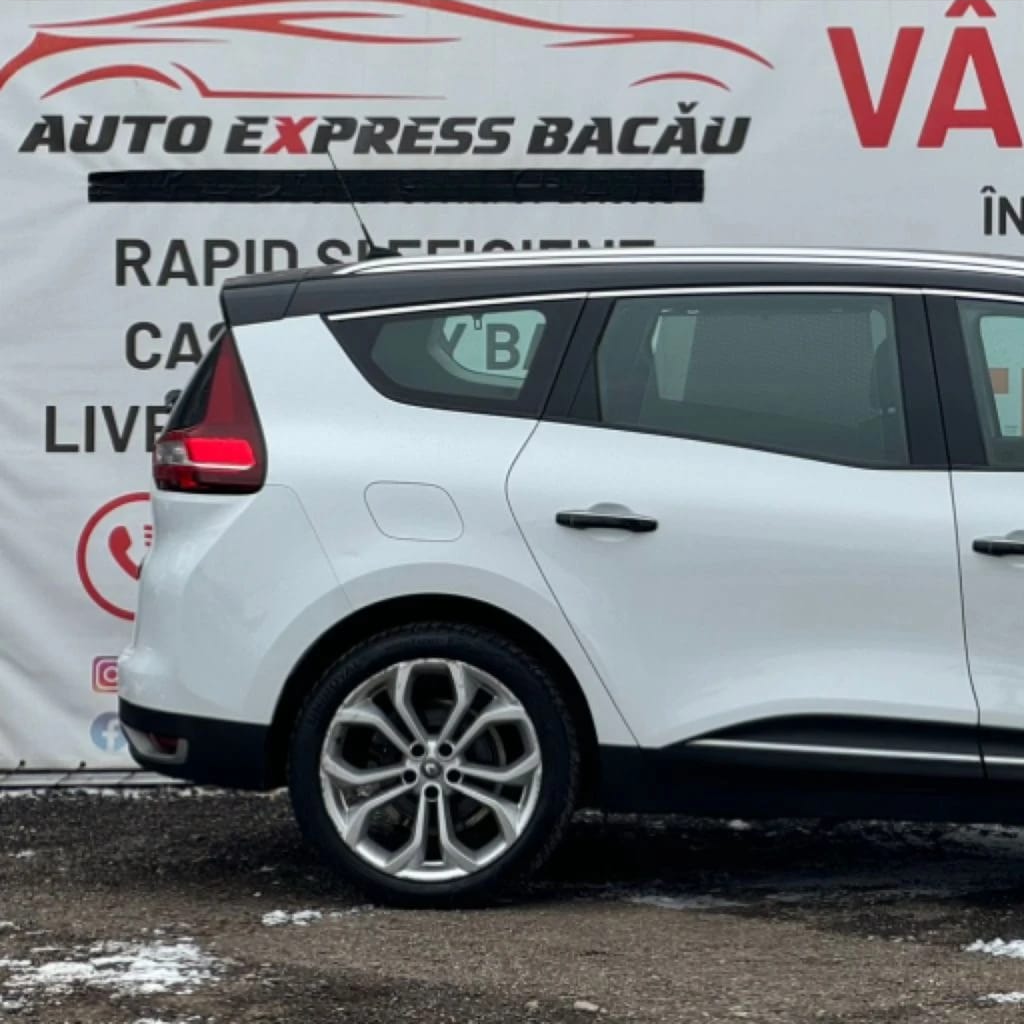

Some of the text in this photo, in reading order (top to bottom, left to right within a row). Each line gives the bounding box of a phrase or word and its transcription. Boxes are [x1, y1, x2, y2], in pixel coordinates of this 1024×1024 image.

[18, 101, 752, 156] AUTO EXPRESS BACĂU
[115, 238, 298, 287] RAPID
